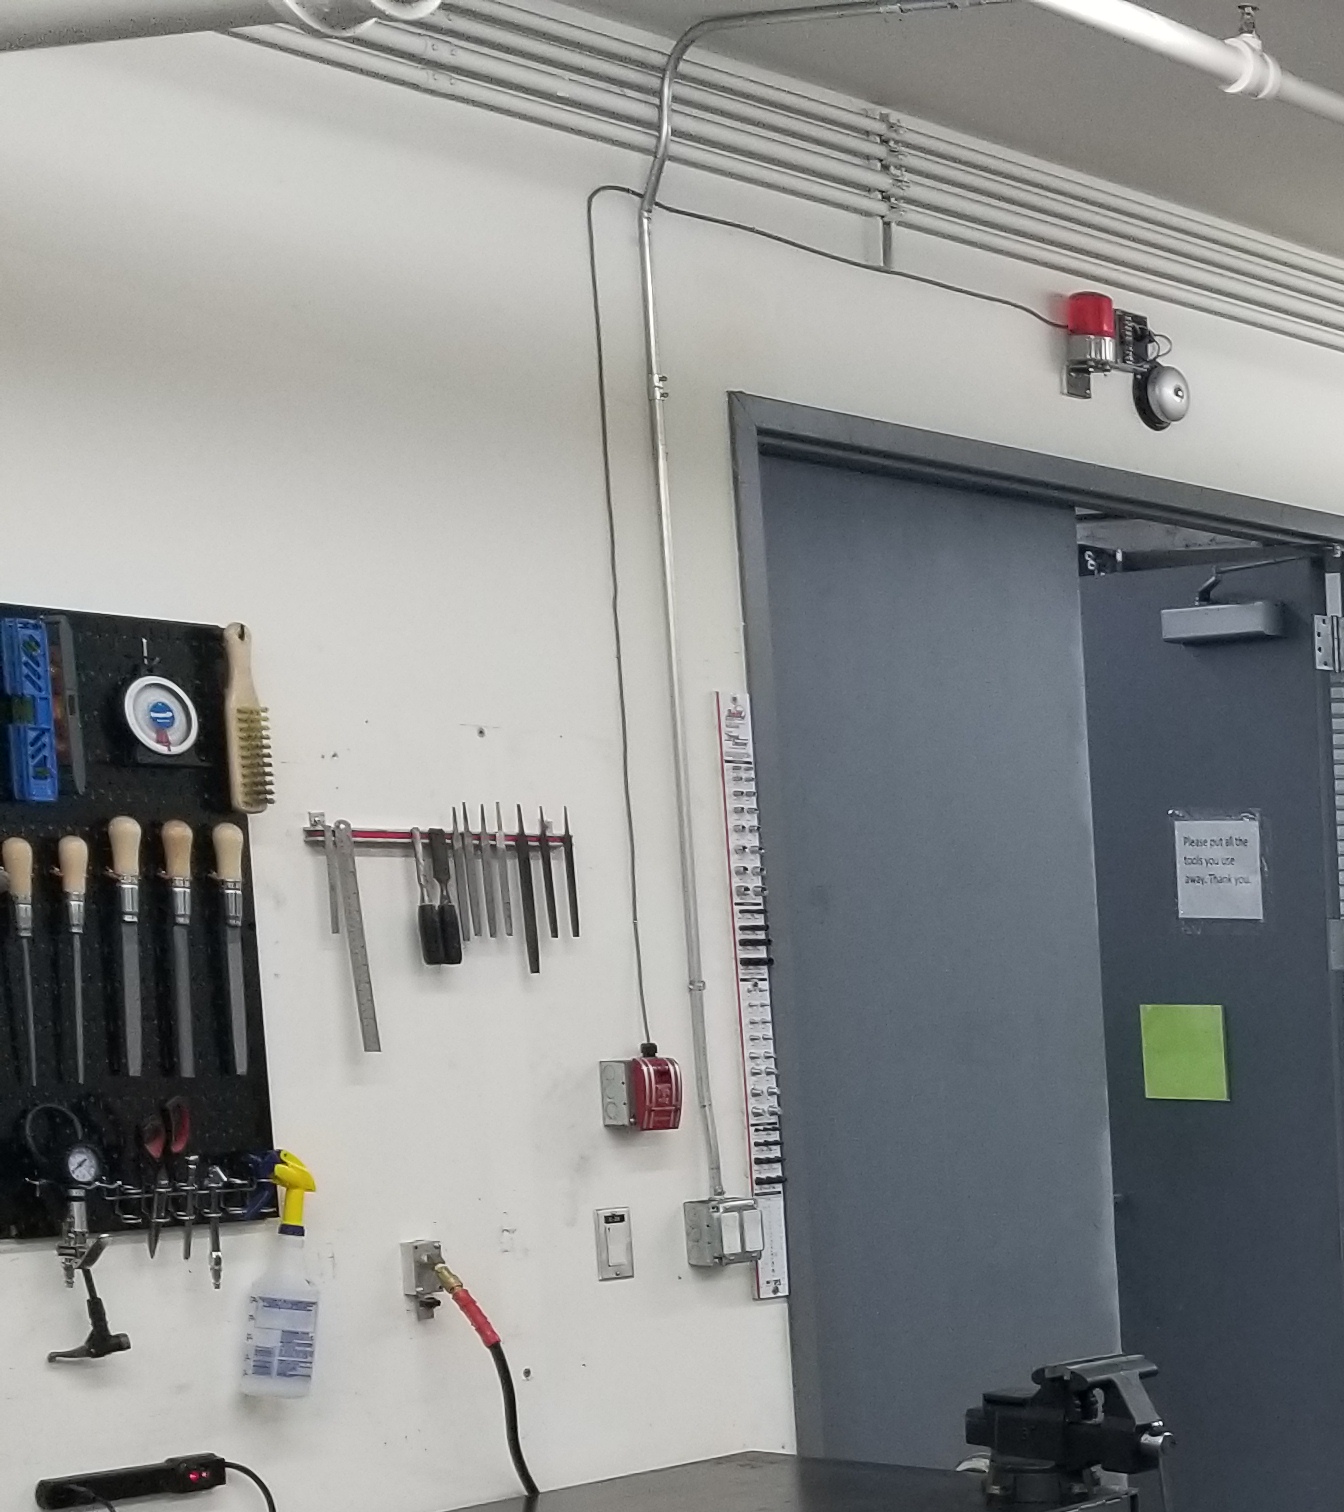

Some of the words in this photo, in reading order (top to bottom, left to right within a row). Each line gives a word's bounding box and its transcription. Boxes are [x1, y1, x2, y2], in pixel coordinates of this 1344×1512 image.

[1183, 836, 1208, 847] Please
[1210, 837, 1223, 848] put
[1226, 836, 1234, 846] all
[1235, 837, 1248, 847] the
[1184, 856, 1202, 866] tools
[1204, 858, 1219, 867] you
[1222, 858, 1236, 866] use
[1208, 874, 1232, 884] Thank
